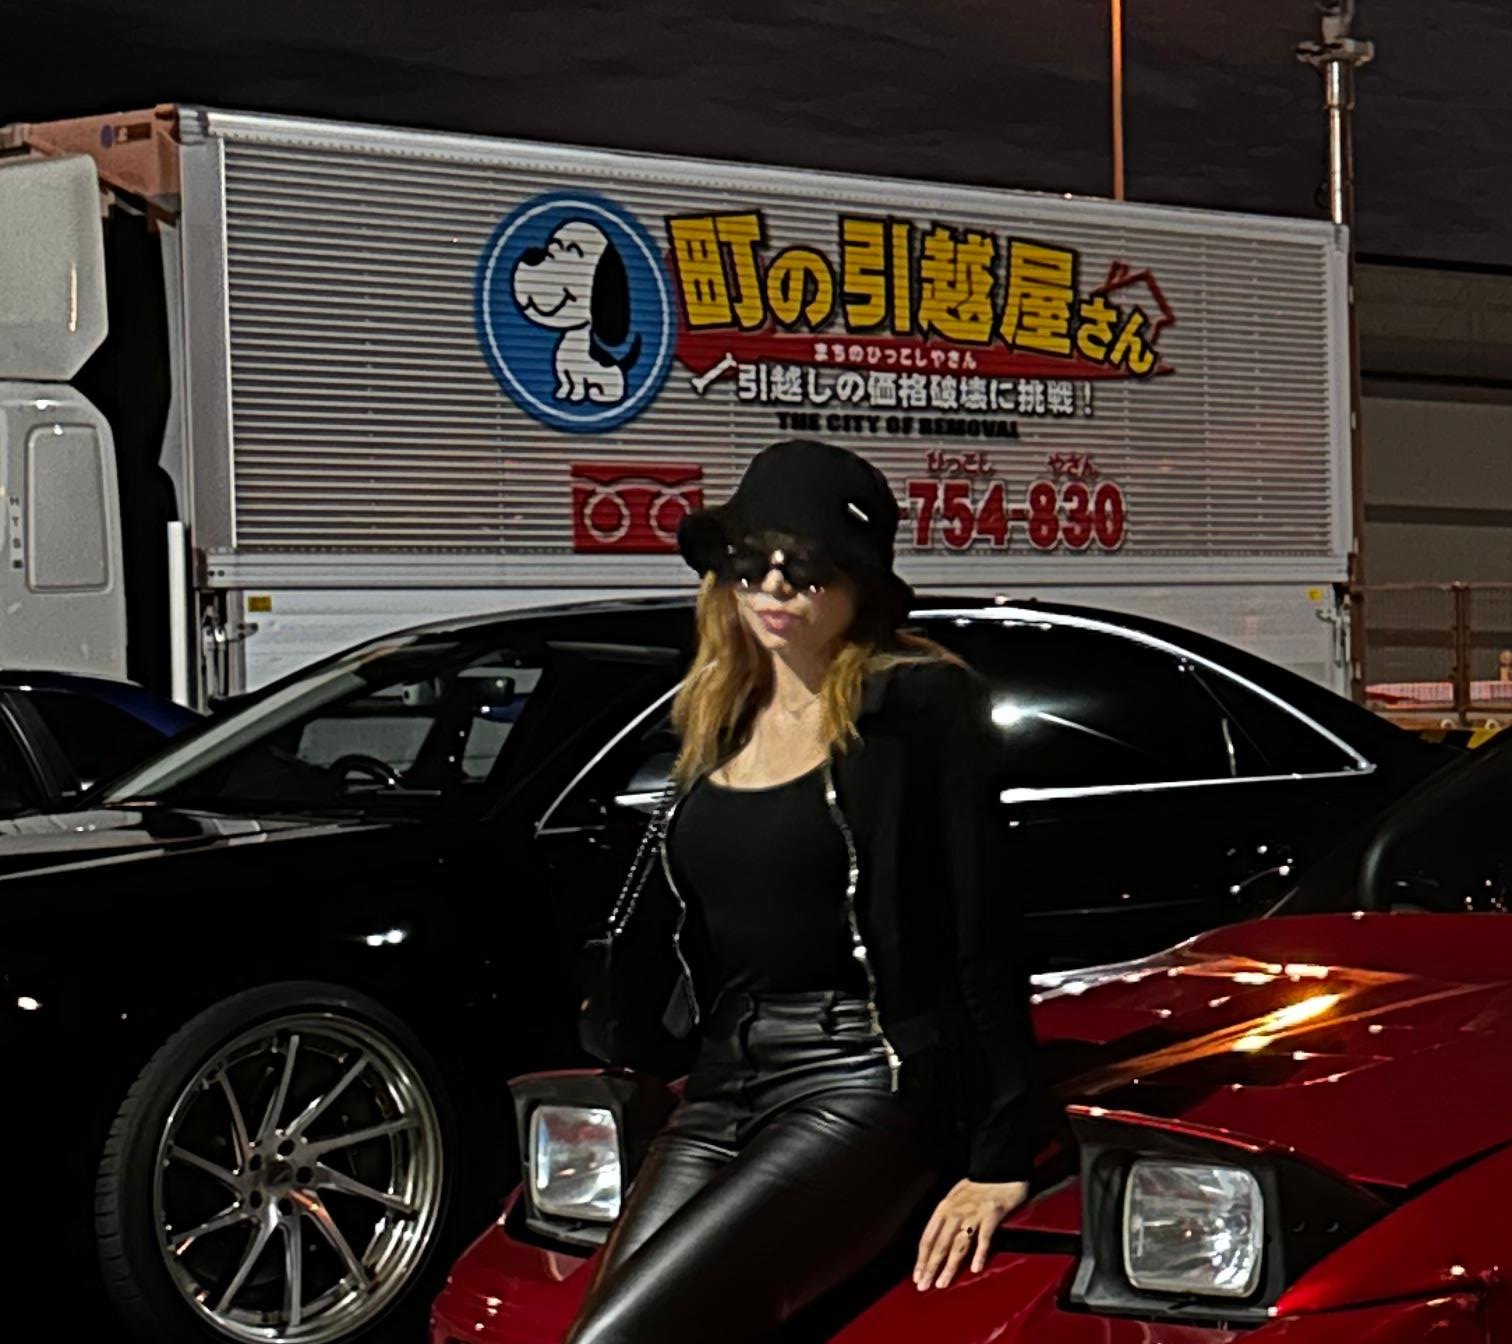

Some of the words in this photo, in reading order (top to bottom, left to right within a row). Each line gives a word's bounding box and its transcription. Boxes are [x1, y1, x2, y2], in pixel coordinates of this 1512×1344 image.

[667, 211, 1158, 375] 町の引越屋さん
[814, 342, 978, 370] まちのひっこしやさん
[776, 412, 820, 431] THE
[826, 413, 881, 433] CITY
[885, 416, 917, 434] OF
[919, 418, 1020, 439] REMOVAL
[926, 449, 994, 475] ひっこし
